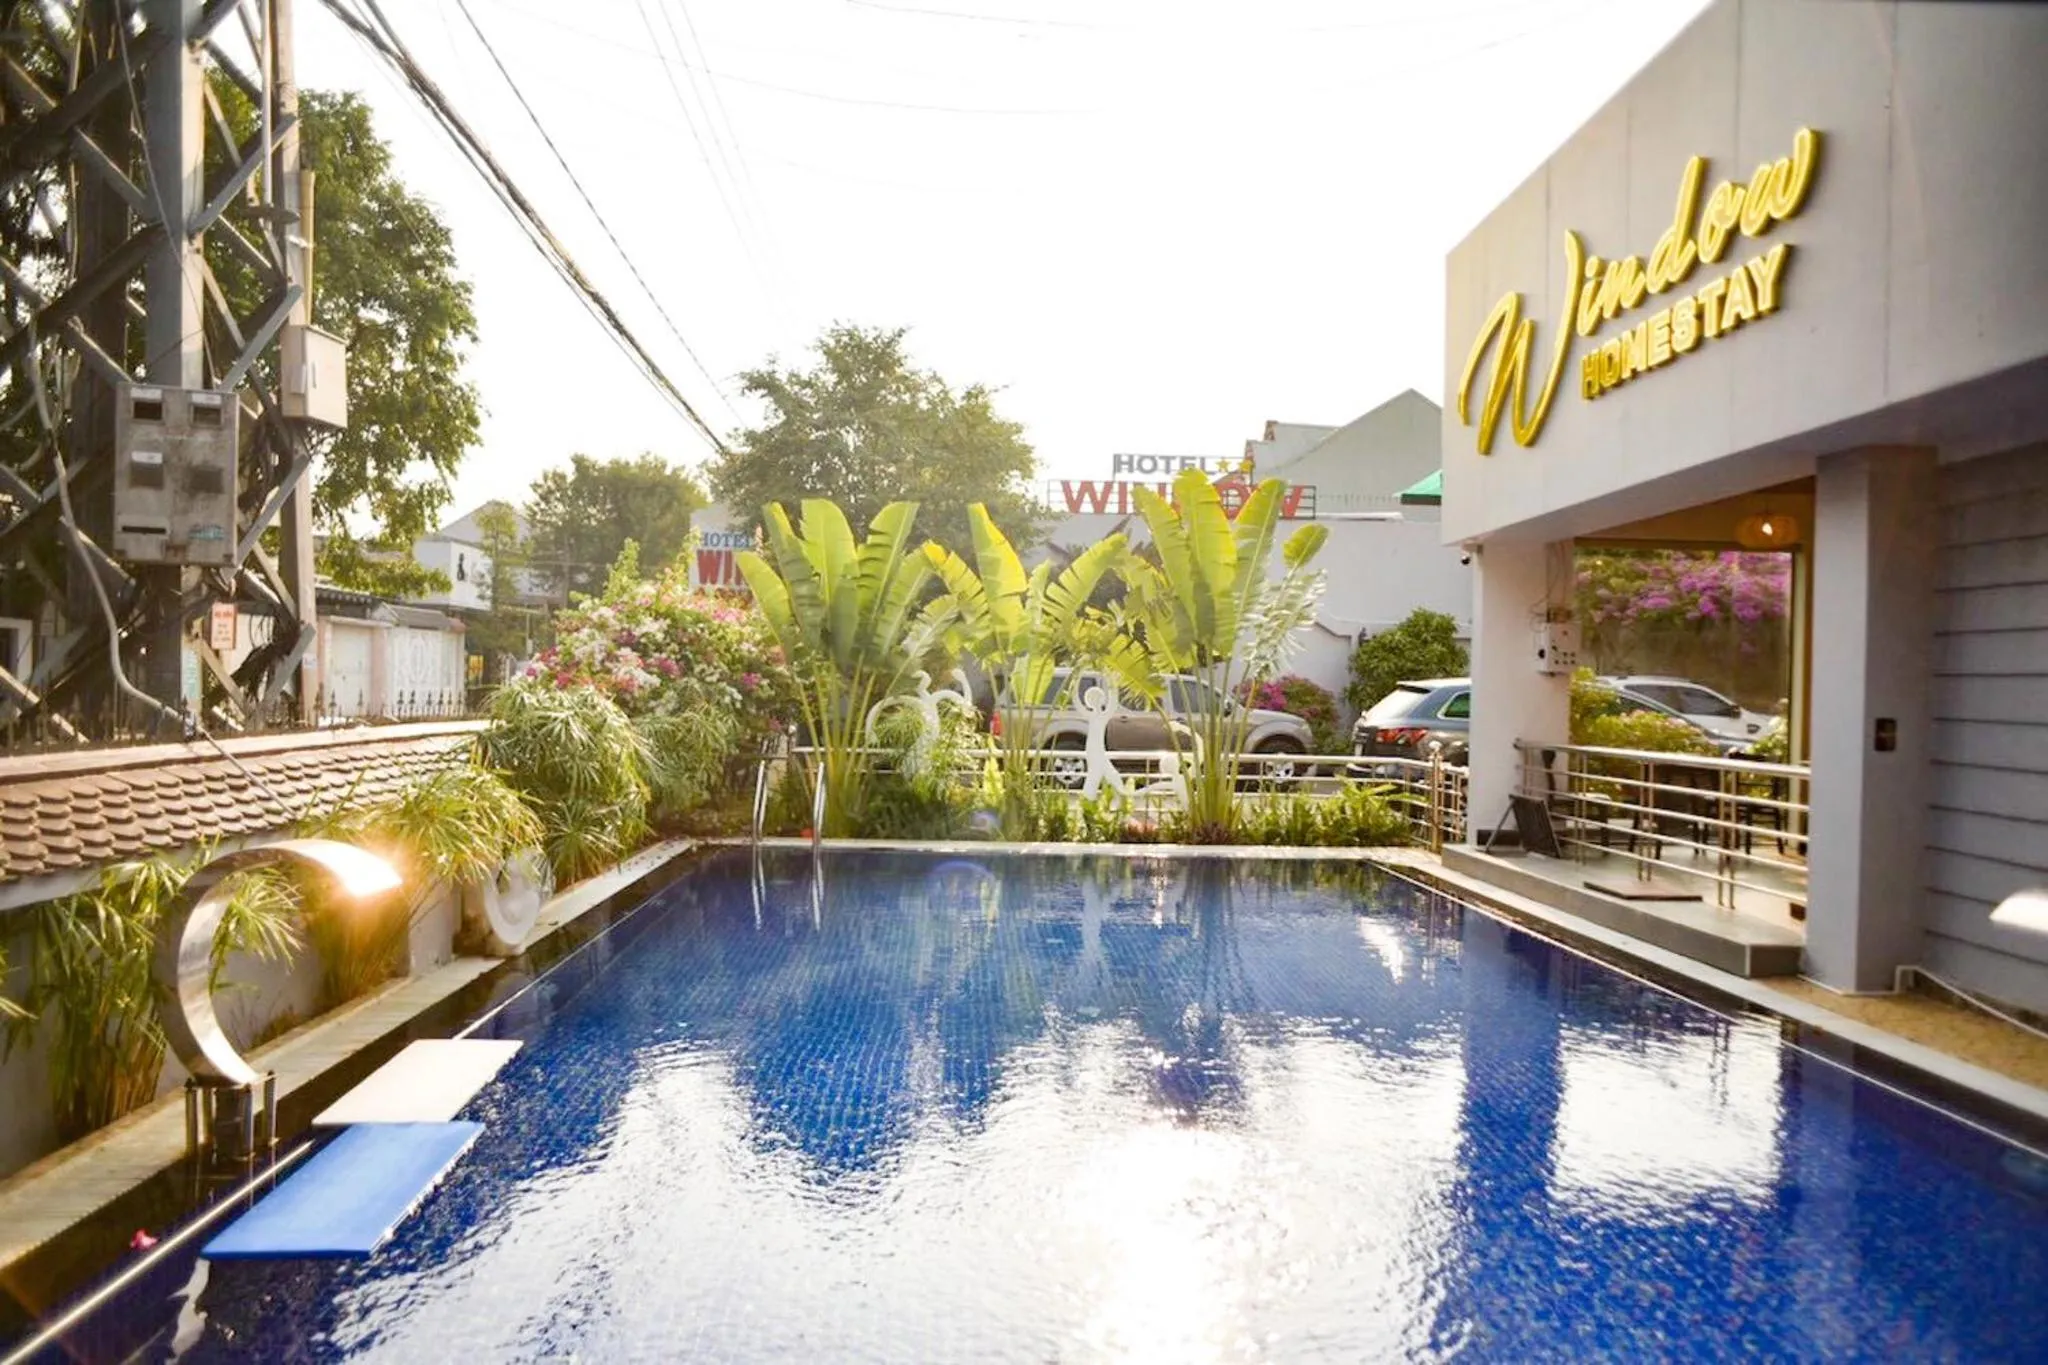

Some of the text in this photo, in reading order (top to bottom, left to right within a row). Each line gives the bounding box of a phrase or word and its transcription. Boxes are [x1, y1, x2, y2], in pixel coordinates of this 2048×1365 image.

[1458, 127, 1819, 455] Window
[1581, 243, 1792, 400] HOMESTAY
[1115, 454, 1216, 475] HOTEL
